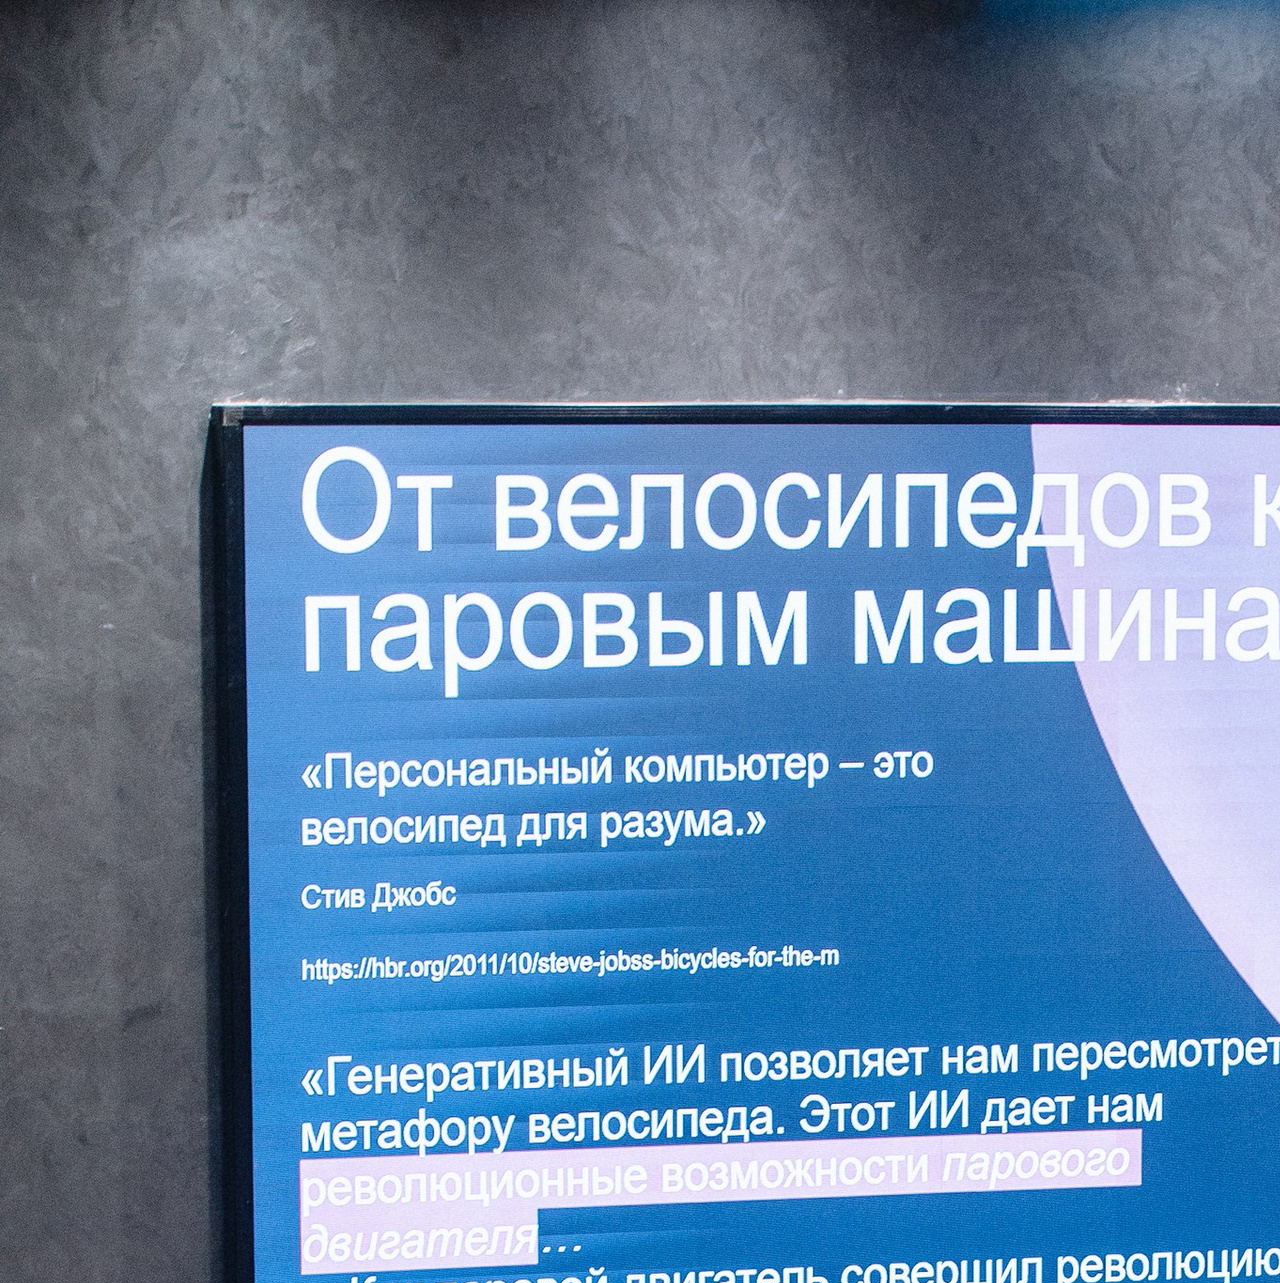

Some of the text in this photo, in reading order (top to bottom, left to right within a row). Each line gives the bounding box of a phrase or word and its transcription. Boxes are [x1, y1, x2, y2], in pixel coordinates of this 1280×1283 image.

[302, 446, 452, 553] От
[496, 471, 1214, 568] велосипедов
[305, 591, 807, 697] паровым
[302, 748, 611, 797] «Персональный
[626, 753, 828, 788] компьютер
[874, 751, 933, 778] это
[302, 810, 765, 847] велосипед для разума.»
[302, 881, 456, 912] Стив Джобс
[302, 945, 839, 984] https://hbr.org/2011/10/steve-jobss-bicycles-for-the-m
[302, 1048, 627, 1102] «Генеративный
[644, 1044, 704, 1084] ИИ
[721, 1047, 929, 1082] позволяет
[943, 1044, 1018, 1074] нам
[302, 1089, 1162, 1156] метафору велосипеда. Этот ИИ дает нам
[305, 1145, 1131, 1216] революционные возможности парового
